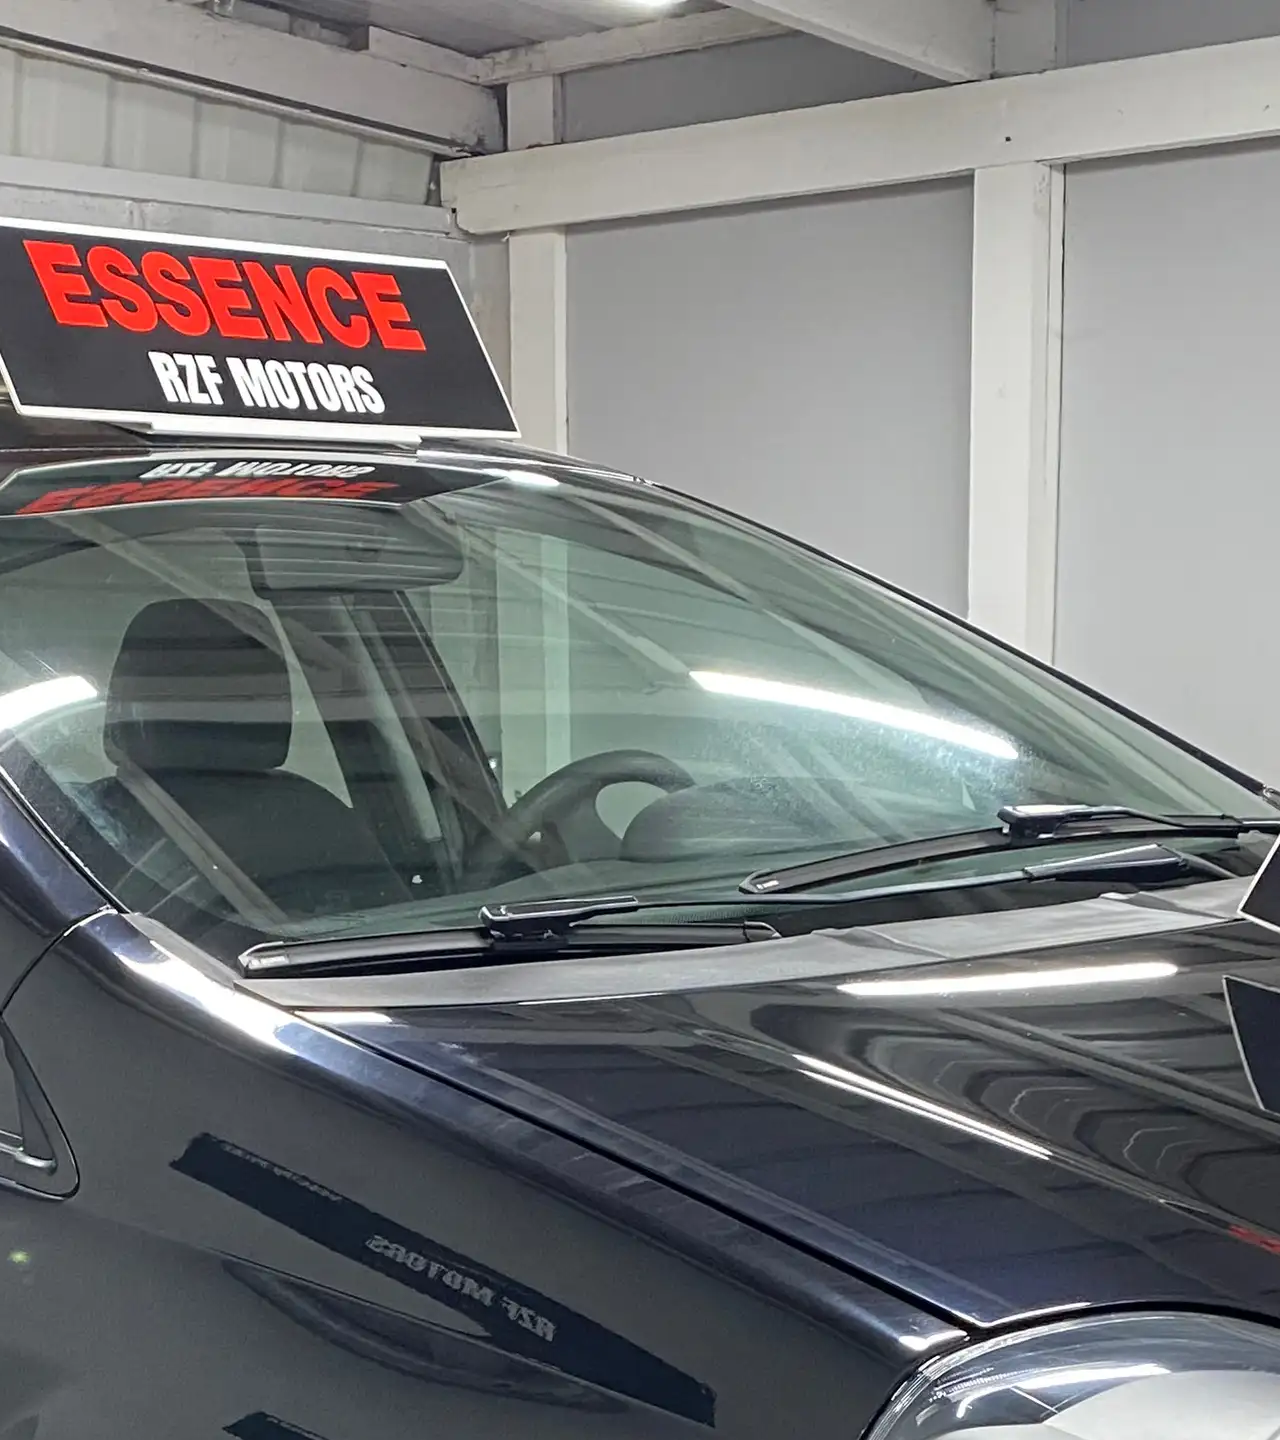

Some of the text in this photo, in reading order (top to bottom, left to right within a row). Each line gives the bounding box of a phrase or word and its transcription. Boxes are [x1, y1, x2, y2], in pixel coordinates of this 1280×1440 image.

[22, 239, 427, 353] ESSENCE
[147, 350, 387, 415] RZF MOTORS
